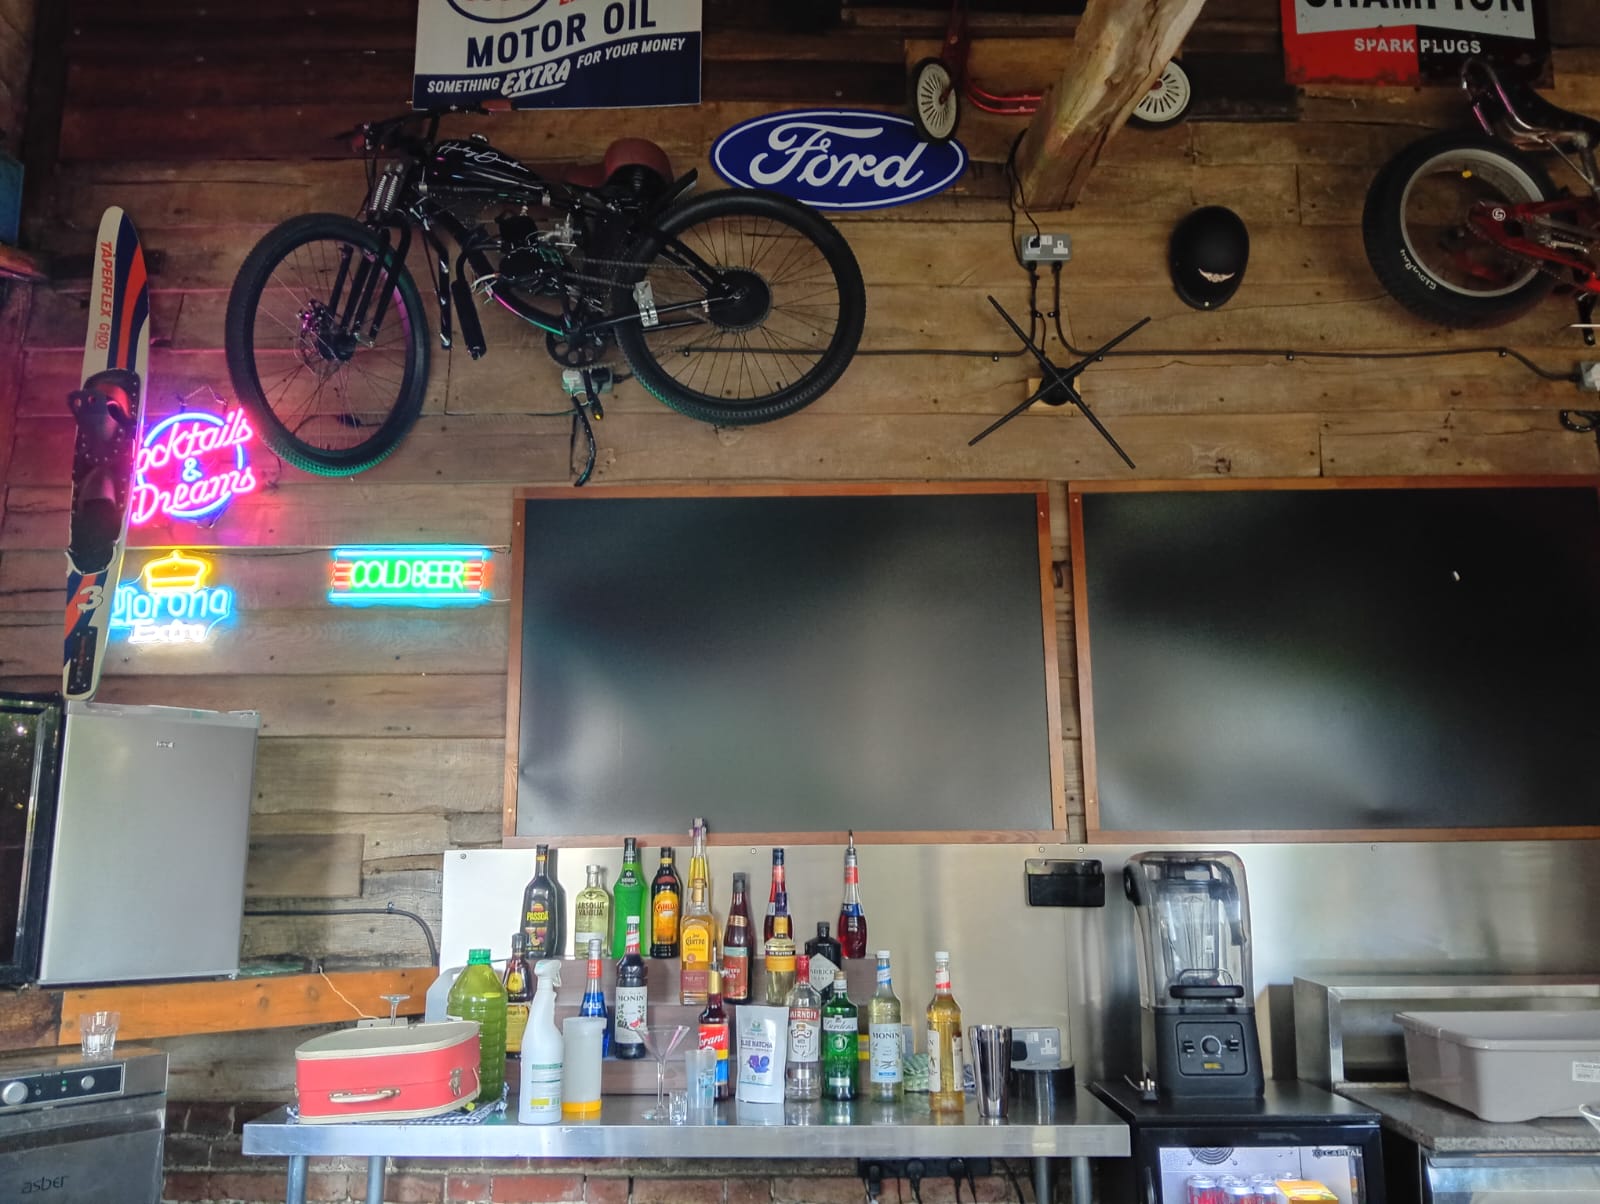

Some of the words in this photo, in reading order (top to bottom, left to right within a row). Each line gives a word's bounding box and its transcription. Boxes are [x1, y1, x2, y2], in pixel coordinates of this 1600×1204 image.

[466, 12, 586, 69] MOTOR
[603, 0, 657, 35] OIL
[1354, 38, 1415, 53] SPARK
[1420, 39, 1481, 54] PLUGS
[427, 77, 500, 94] SOMETHING
[501, 59, 571, 97] EXTRA
[576, 51, 601, 69] FOR
[605, 41, 638, 62] YOUR
[641, 37, 686, 53] MONEY
[749, 122, 930, 188] Ford
[100, 240, 113, 317] TAPERFLEX
[137, 408, 253, 473] ocktails
[182, 457, 203, 482] &
[131, 467, 256, 523] Dreams
[350, 560, 411, 588] COLD
[411, 560, 464, 590] BEER
[77, 584, 103, 611] 3
[113, 586, 231, 624] Corona
[698, 1031, 725, 1047] Torani
[752, 1040, 773, 1049] MATCHA
[872, 1031, 900, 1039] MONIN
[21, 1175, 70, 1194] asber
